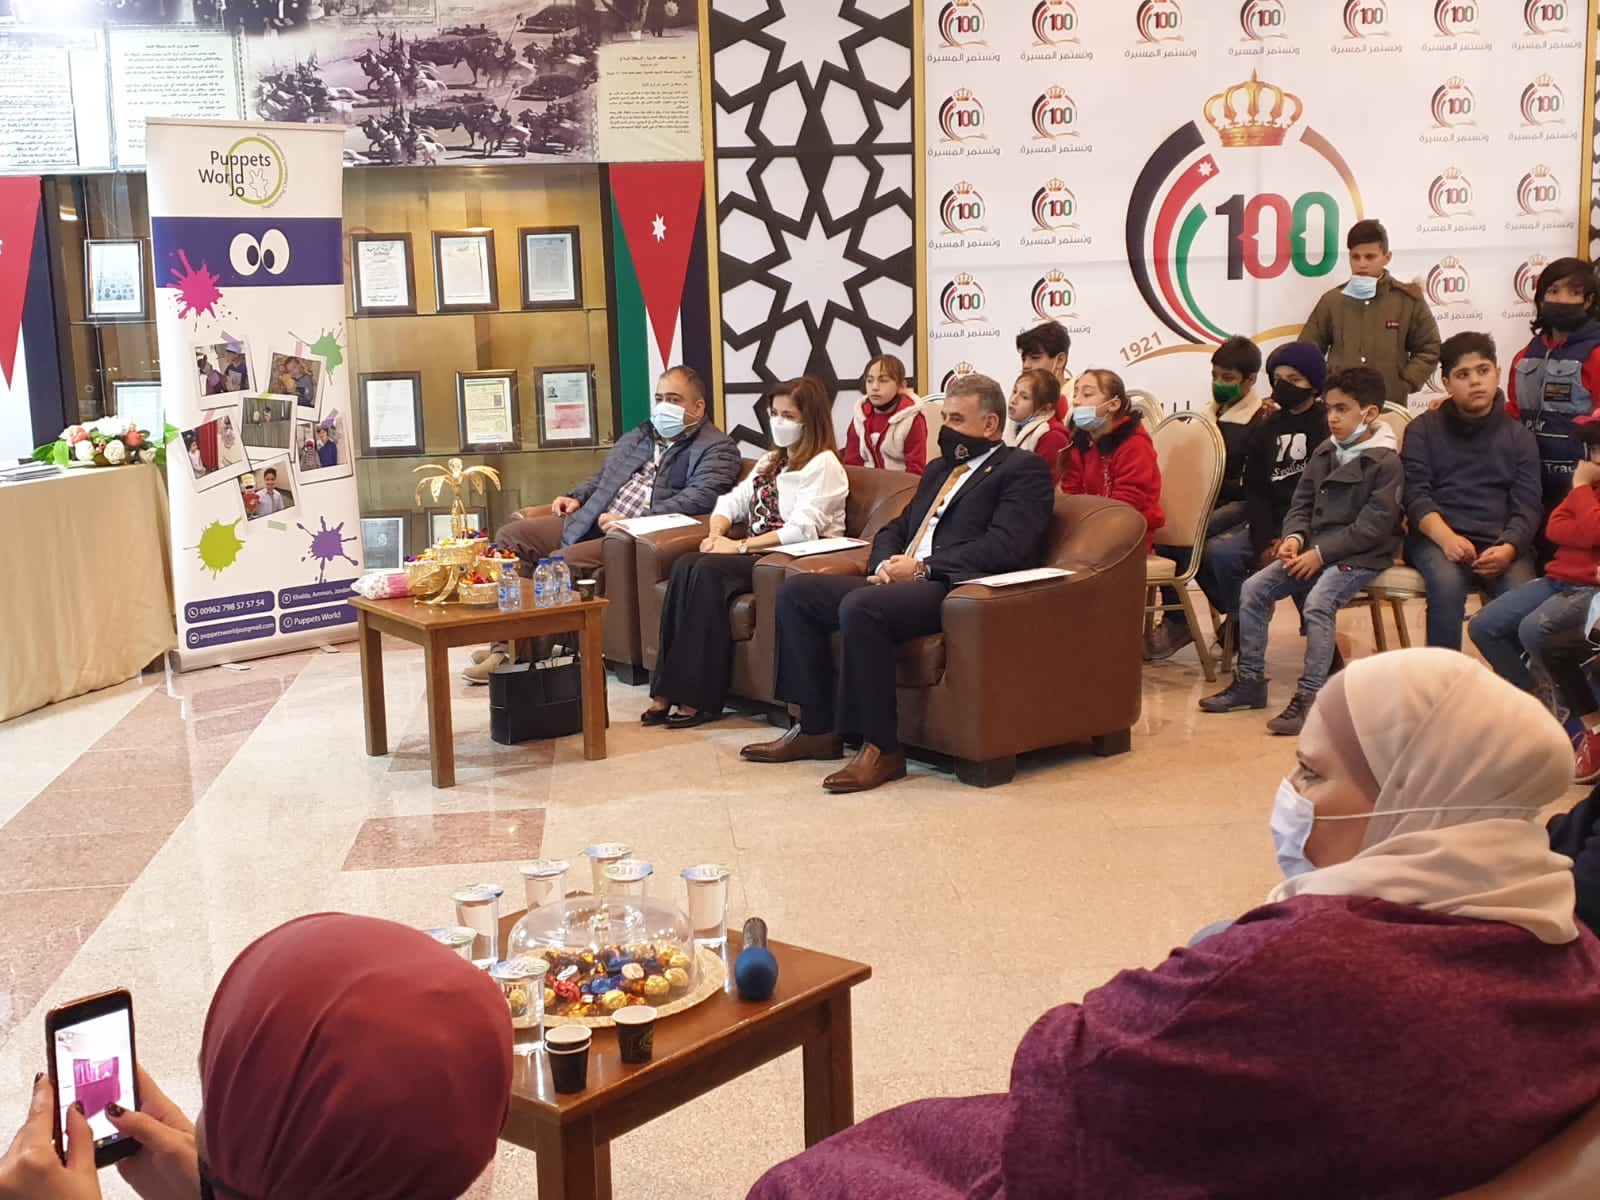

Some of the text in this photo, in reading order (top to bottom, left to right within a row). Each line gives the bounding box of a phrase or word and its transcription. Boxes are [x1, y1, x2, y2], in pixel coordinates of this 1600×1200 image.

[1153, 11, 1177, 29] 100
[1257, 9, 1280, 27] 100
[1360, 7, 1384, 24] 100
[1451, 6, 1474, 23] 100
[1541, 4, 1564, 21] 100
[956, 15, 980, 32] 100
[1049, 13, 1073, 31] 100
[1124, 48, 1197, 58] وتستمر المسيرة
[1228, 46, 1300, 56] وتستمر المسيرة
[1331, 44, 1402, 53] وتستمر المسيرة
[1421, 42, 1493, 52] وتستمر المسيرة
[1512, 40, 1582, 50] وتستمر المسيرة
[927, 54, 1000, 63] وتستمر المسيرة
[1020, 51, 1093, 61] وتستمر المسيرة
[1448, 97, 1472, 115] 100
[1537, 95, 1560, 112] 100
[956, 109, 980, 127] 100
[1049, 107, 1073, 125] 100
[1419, 133, 1489, 144] وتستمر المسيرة
[1508, 131, 1578, 141] وتستمر المسيرة
[928, 147, 1000, 157] وتستمر المسيرة
[1020, 144, 1093, 154] وتستمر المسيرة
[210, 150, 271, 168] Puppets
[198, 168, 244, 184] World
[229, 184, 245, 197] Jo
[1445, 187, 1468, 204] 100
[1534, 185, 1557, 202] 100
[956, 202, 981, 220] 100
[1048, 199, 1072, 217] 100
[1416, 223, 1487, 232] وتستمر المسيرة
[1504, 222, 1574, 231] وتستمر المسيرة
[928, 239, 1000, 249] وتستمر المسيرة
[1020, 236, 1092, 246] وتستمر المسيرة
[1215, 191, 1340, 280] 100
[1443, 276, 1465, 293] 100
[957, 293, 981, 310] 100
[1048, 290, 1071, 307] 100
[929, 329, 1000, 339] وتستمر المسيرة
[1120, 331, 1162, 361] 1921
[200, 605, 220, 615] 00962
[236, 601, 245, 610] 57
[246, 600, 255, 608] 57
[256, 599, 265, 607] 54
[294, 611, 341, 625] Puppets World
